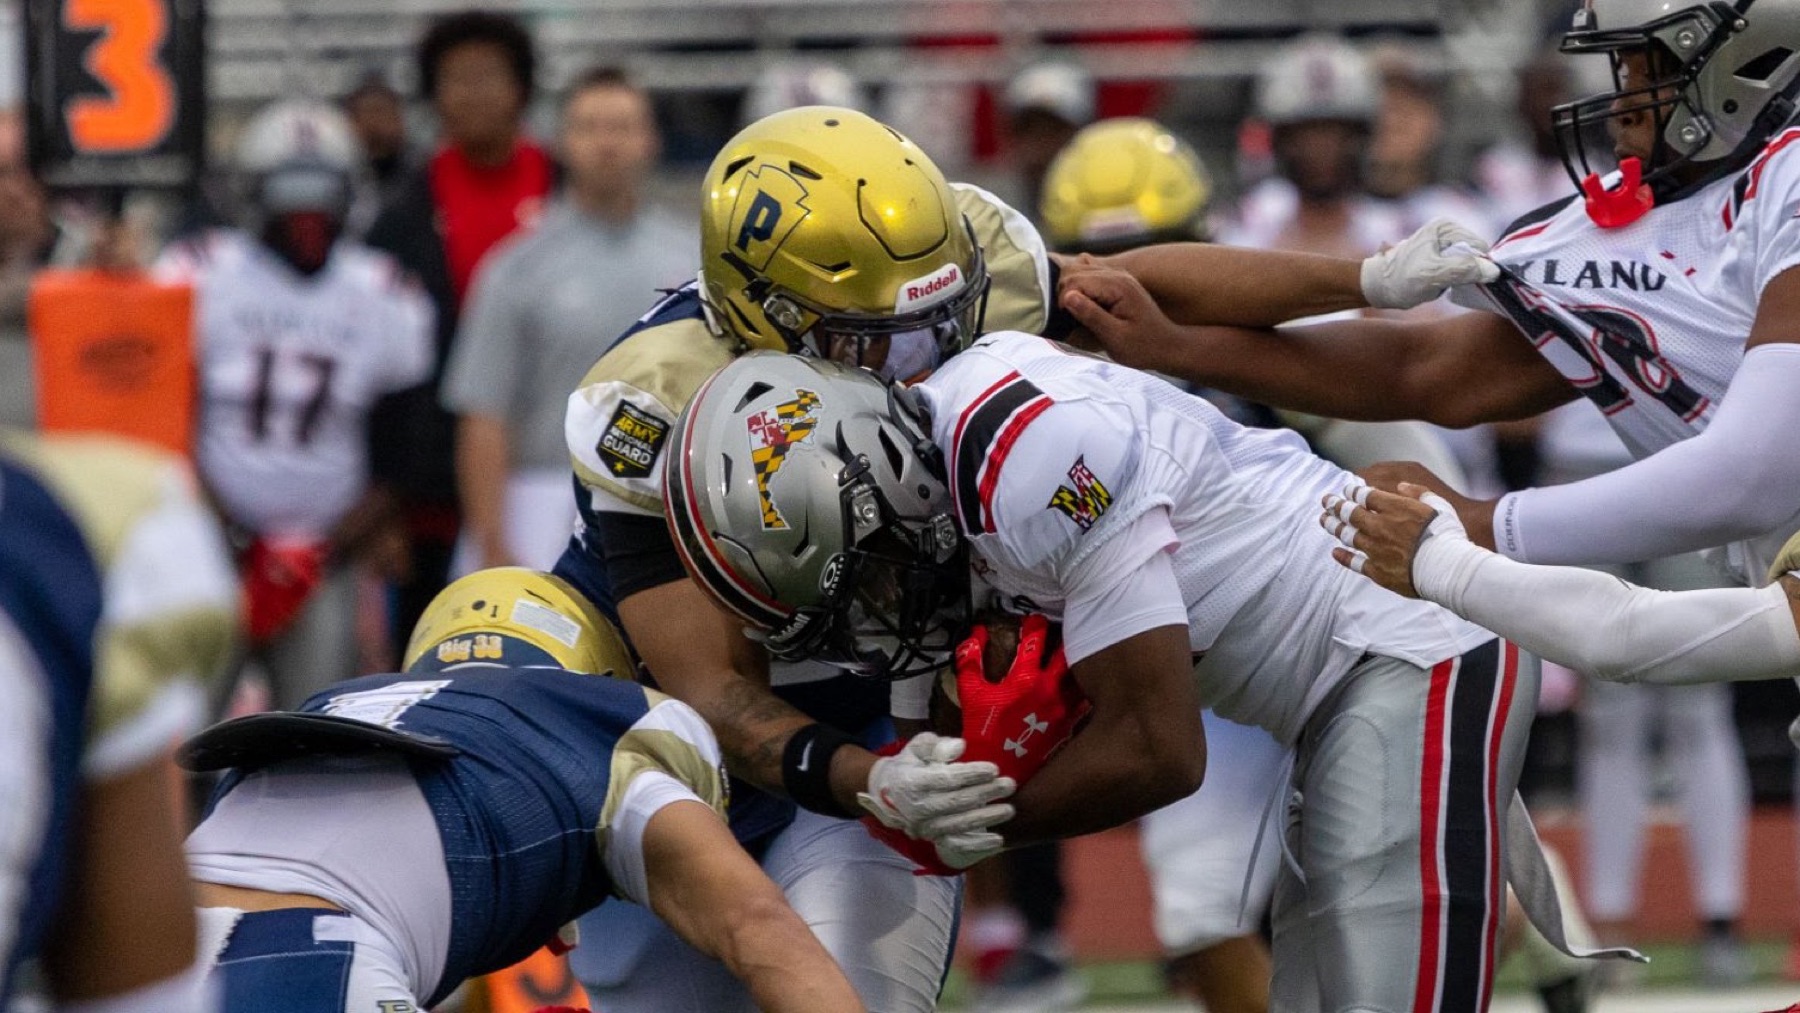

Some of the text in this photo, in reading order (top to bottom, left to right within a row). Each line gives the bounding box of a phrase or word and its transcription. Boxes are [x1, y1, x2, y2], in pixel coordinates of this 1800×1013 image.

[64, 0, 176, 152] 3
[735, 189, 783, 252] P
[907, 268, 958, 301] Riddell
[250, 343, 337, 442] 17
[610, 426, 655, 455] NATIONAL
[615, 416, 661, 444] ARMY
[603, 434, 652, 465] GUARD
